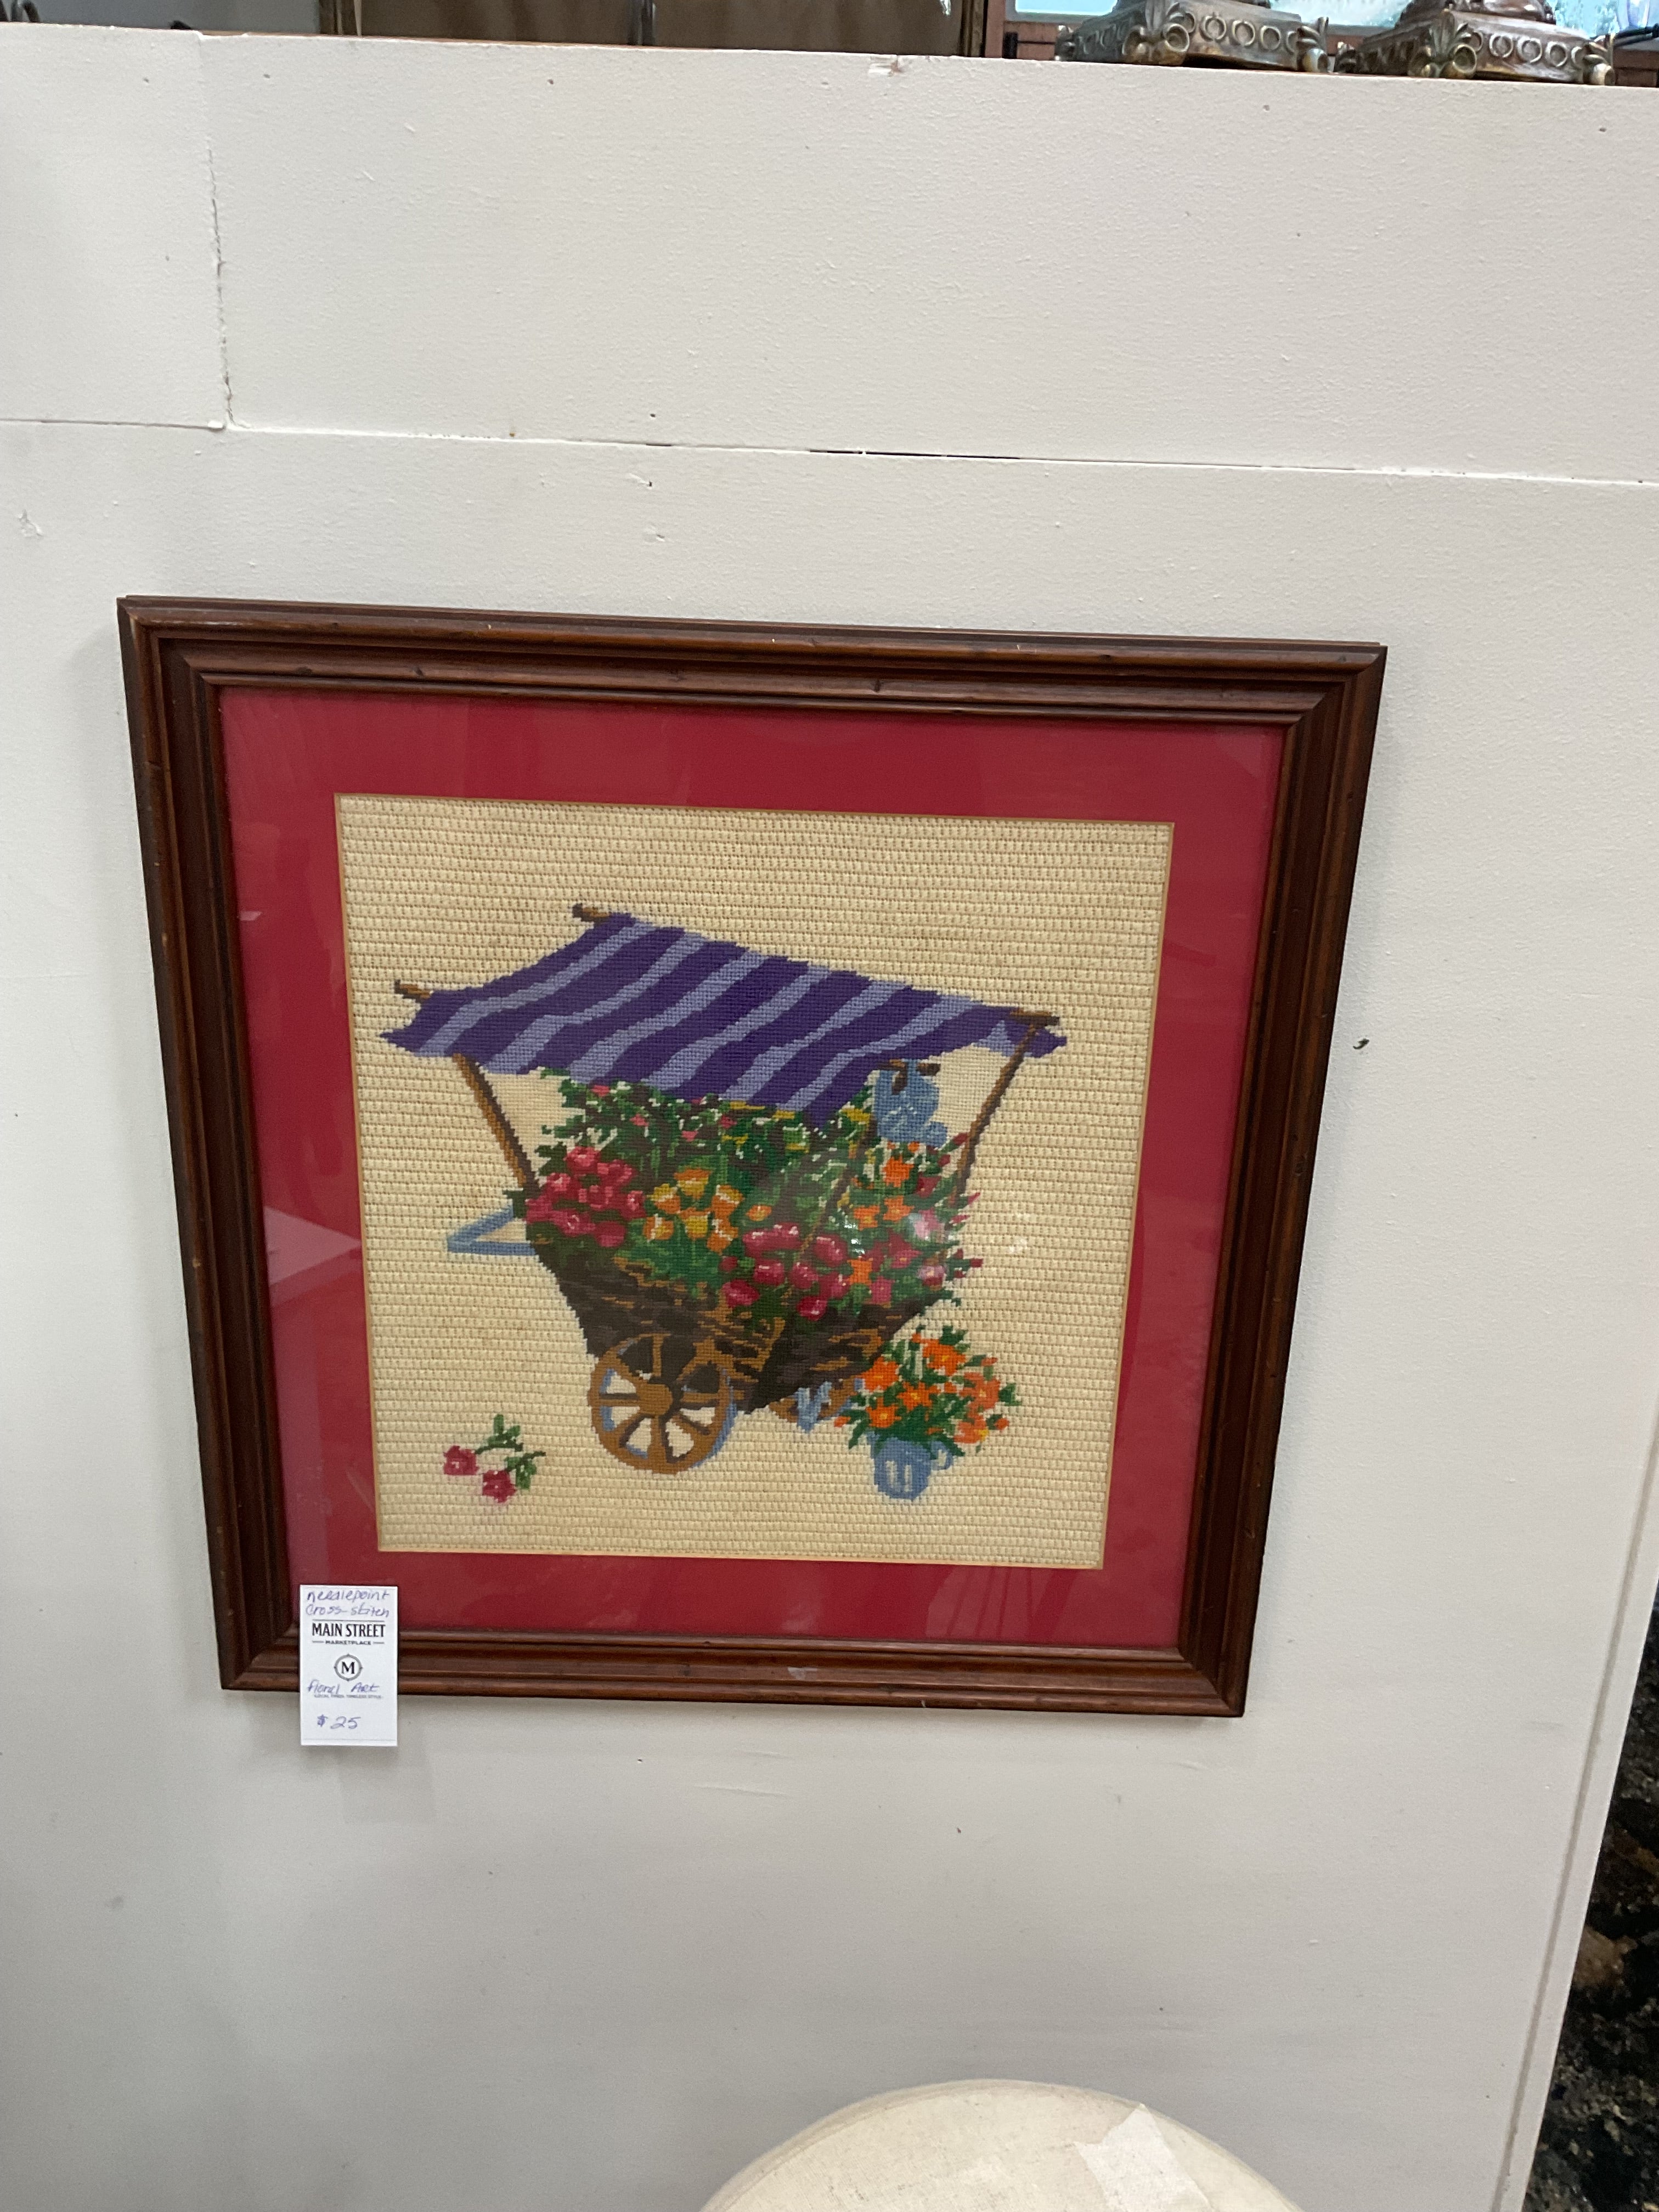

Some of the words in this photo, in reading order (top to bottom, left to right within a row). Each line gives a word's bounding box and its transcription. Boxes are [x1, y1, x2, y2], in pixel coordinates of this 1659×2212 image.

[312, 1622, 342, 1637] MAIN
[346, 1623, 386, 1638] STREET
[341, 1661, 355, 1674] M
